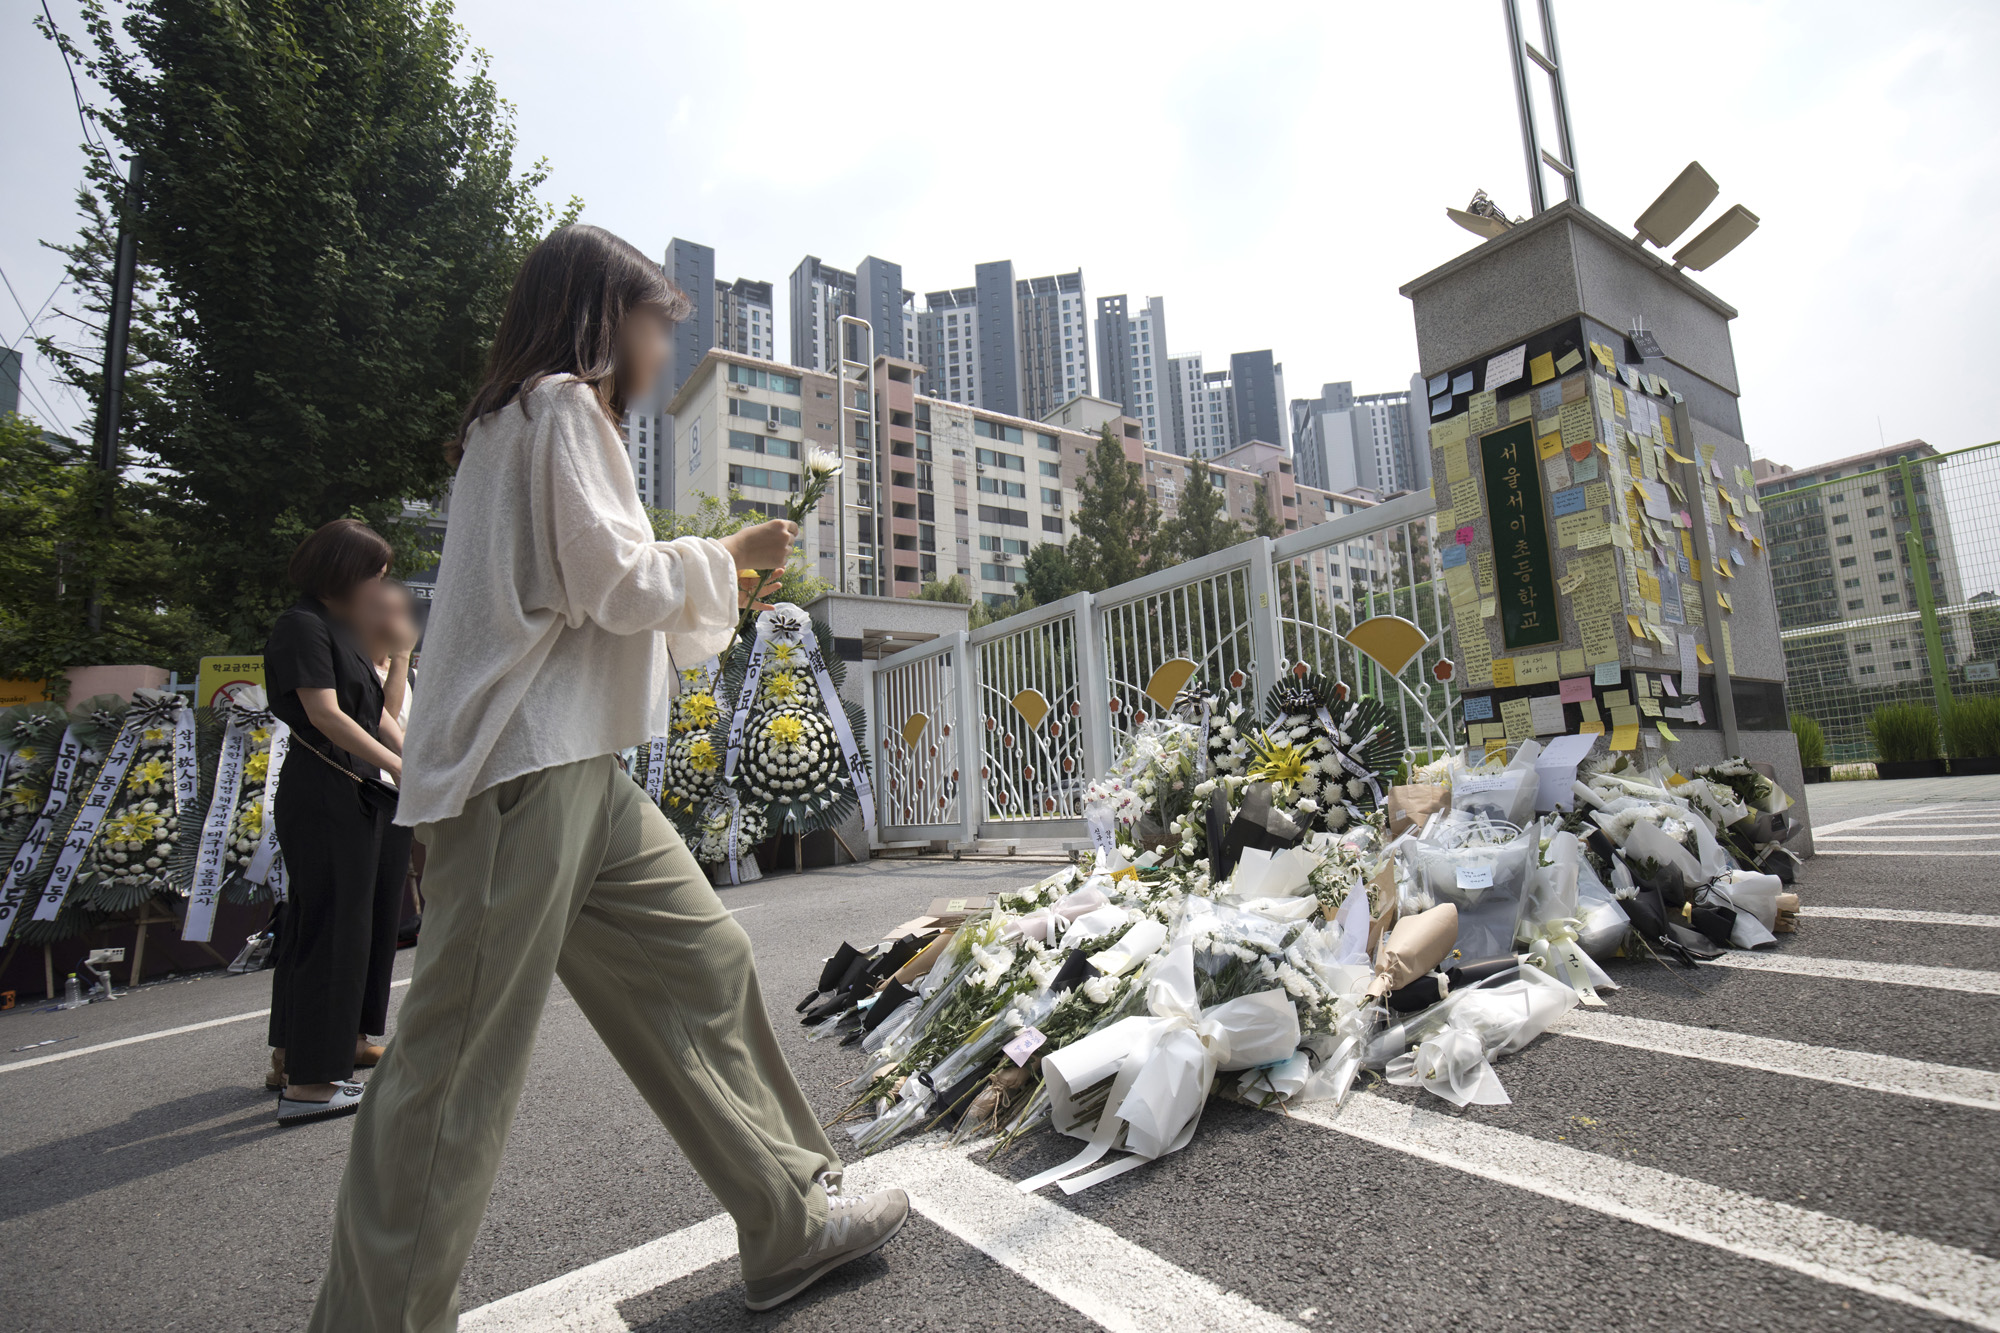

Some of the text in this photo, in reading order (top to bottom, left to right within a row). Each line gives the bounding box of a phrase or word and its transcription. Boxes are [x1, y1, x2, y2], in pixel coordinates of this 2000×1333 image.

[1500, 442, 1540, 630] 서울서이초등학교
[42, 733, 136, 903] 신규 동료 교사 일동
[177, 728, 195, 753] 삼가
